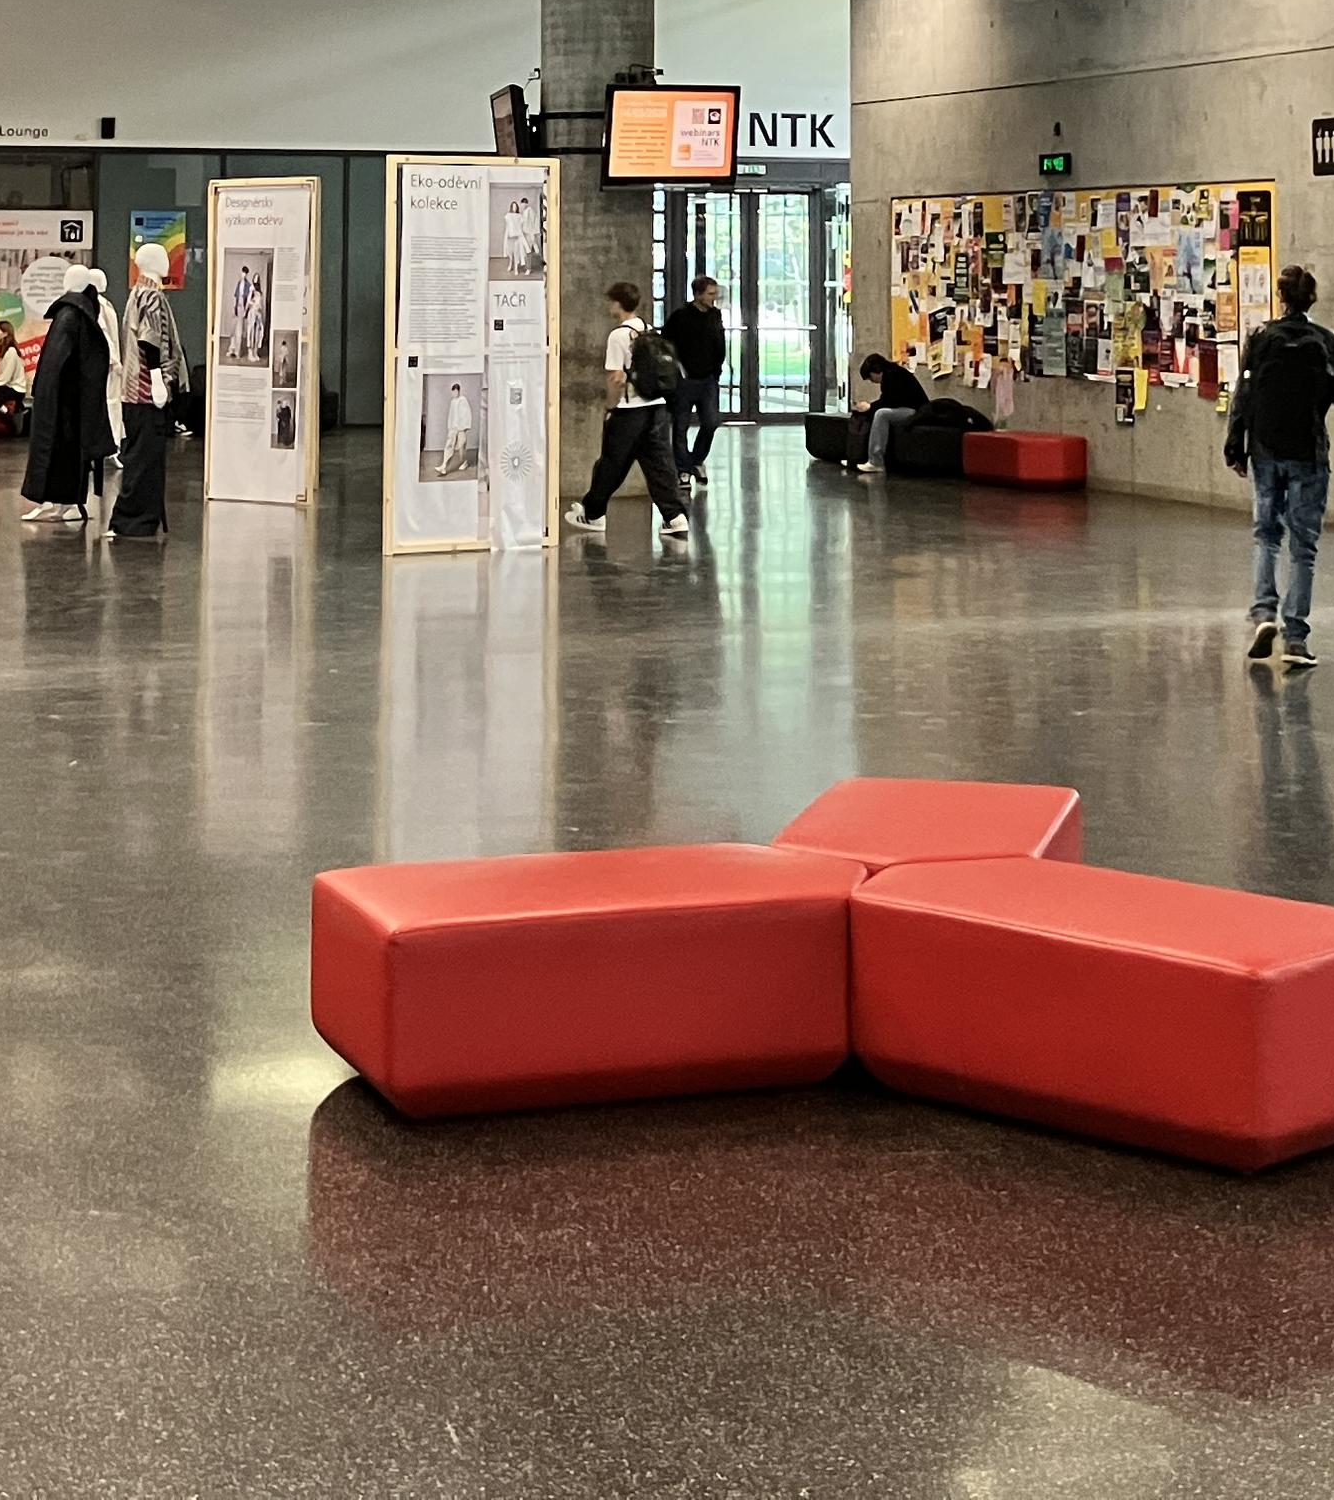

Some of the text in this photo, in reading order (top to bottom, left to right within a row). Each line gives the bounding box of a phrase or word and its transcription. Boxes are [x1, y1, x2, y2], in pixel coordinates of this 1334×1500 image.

[0, 125, 49, 140] Lounge
[681, 128, 720, 137] webinars
[749, 112, 835, 148] NTK
[701, 138, 720, 147] NTK
[410, 173, 482, 191] Eko-oděvní
[410, 196, 458, 211] kolekce
[494, 291, 526, 307] TAČR
